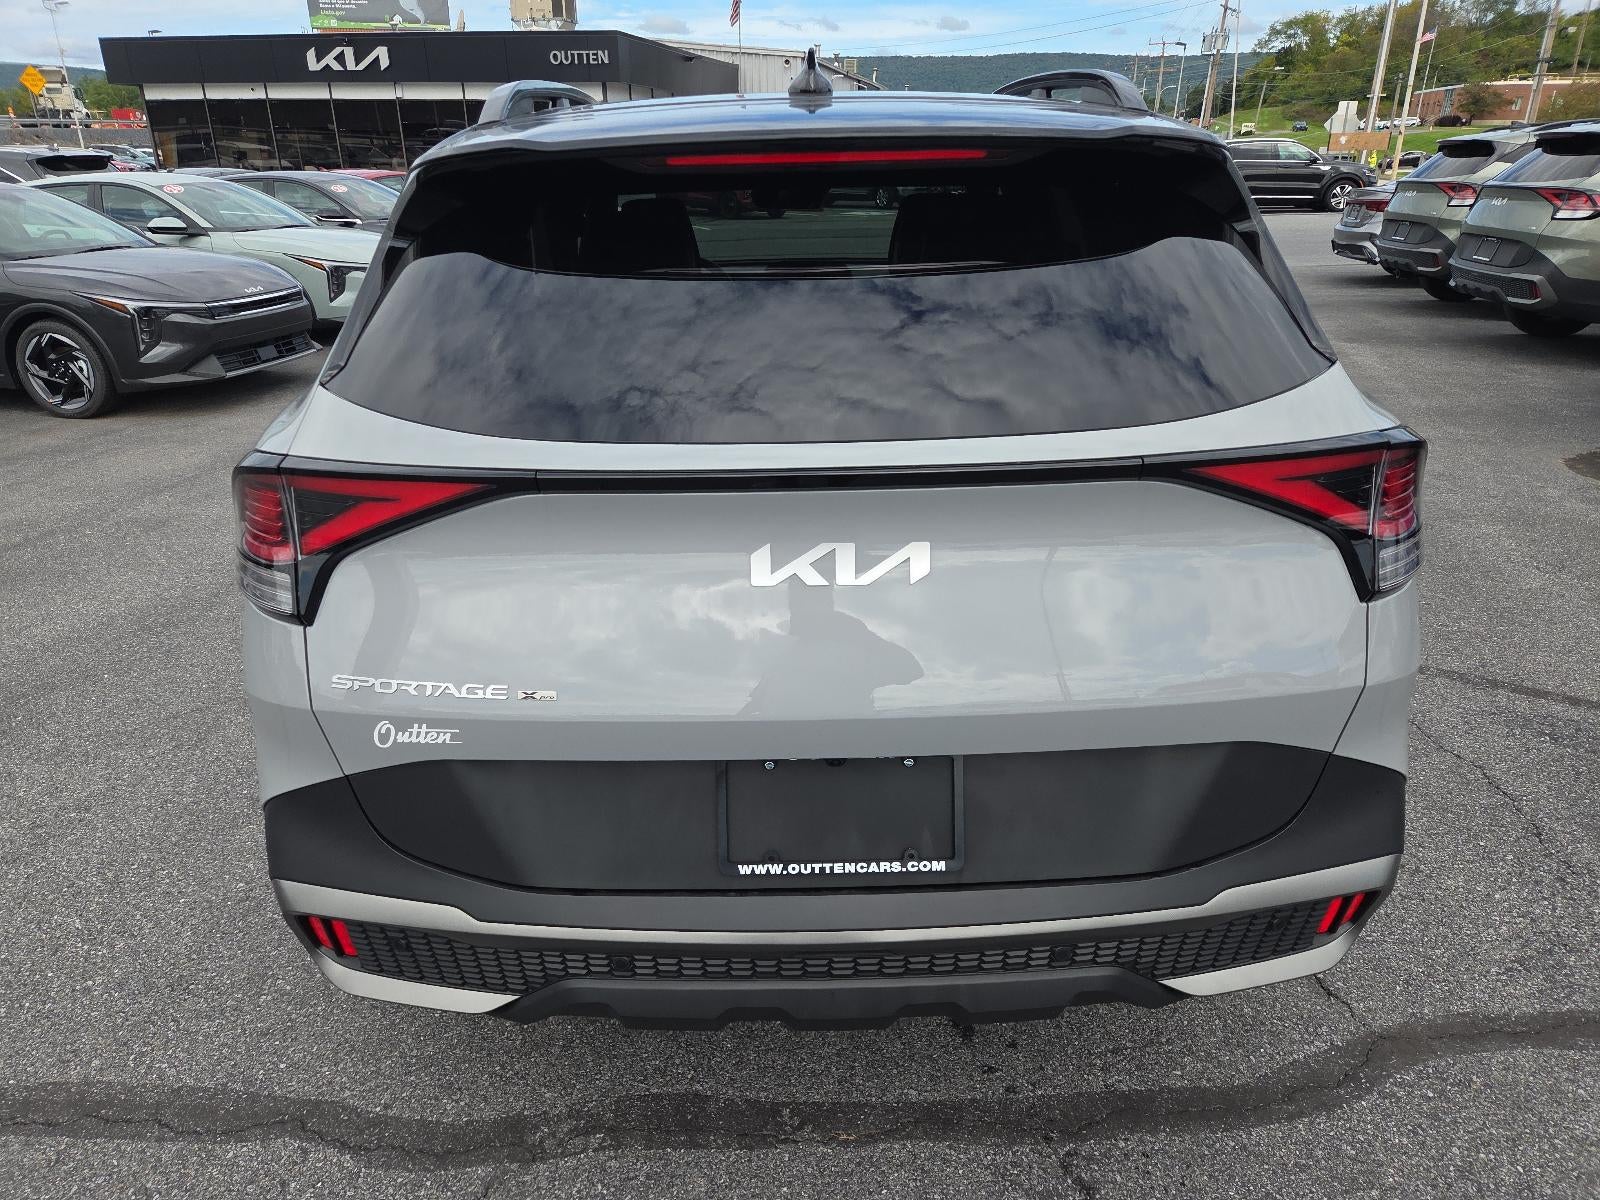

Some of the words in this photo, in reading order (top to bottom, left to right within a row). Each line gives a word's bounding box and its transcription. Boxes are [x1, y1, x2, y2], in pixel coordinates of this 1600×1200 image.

[306, 46, 390, 71] KIA
[550, 50, 609, 65] OUTTEN
[750, 541, 931, 587] KIA
[331, 673, 510, 700] SPORTAGE
[373, 720, 463, 748] Outten
[737, 860, 947, 875] WWW.OUTTENCARS.COM
